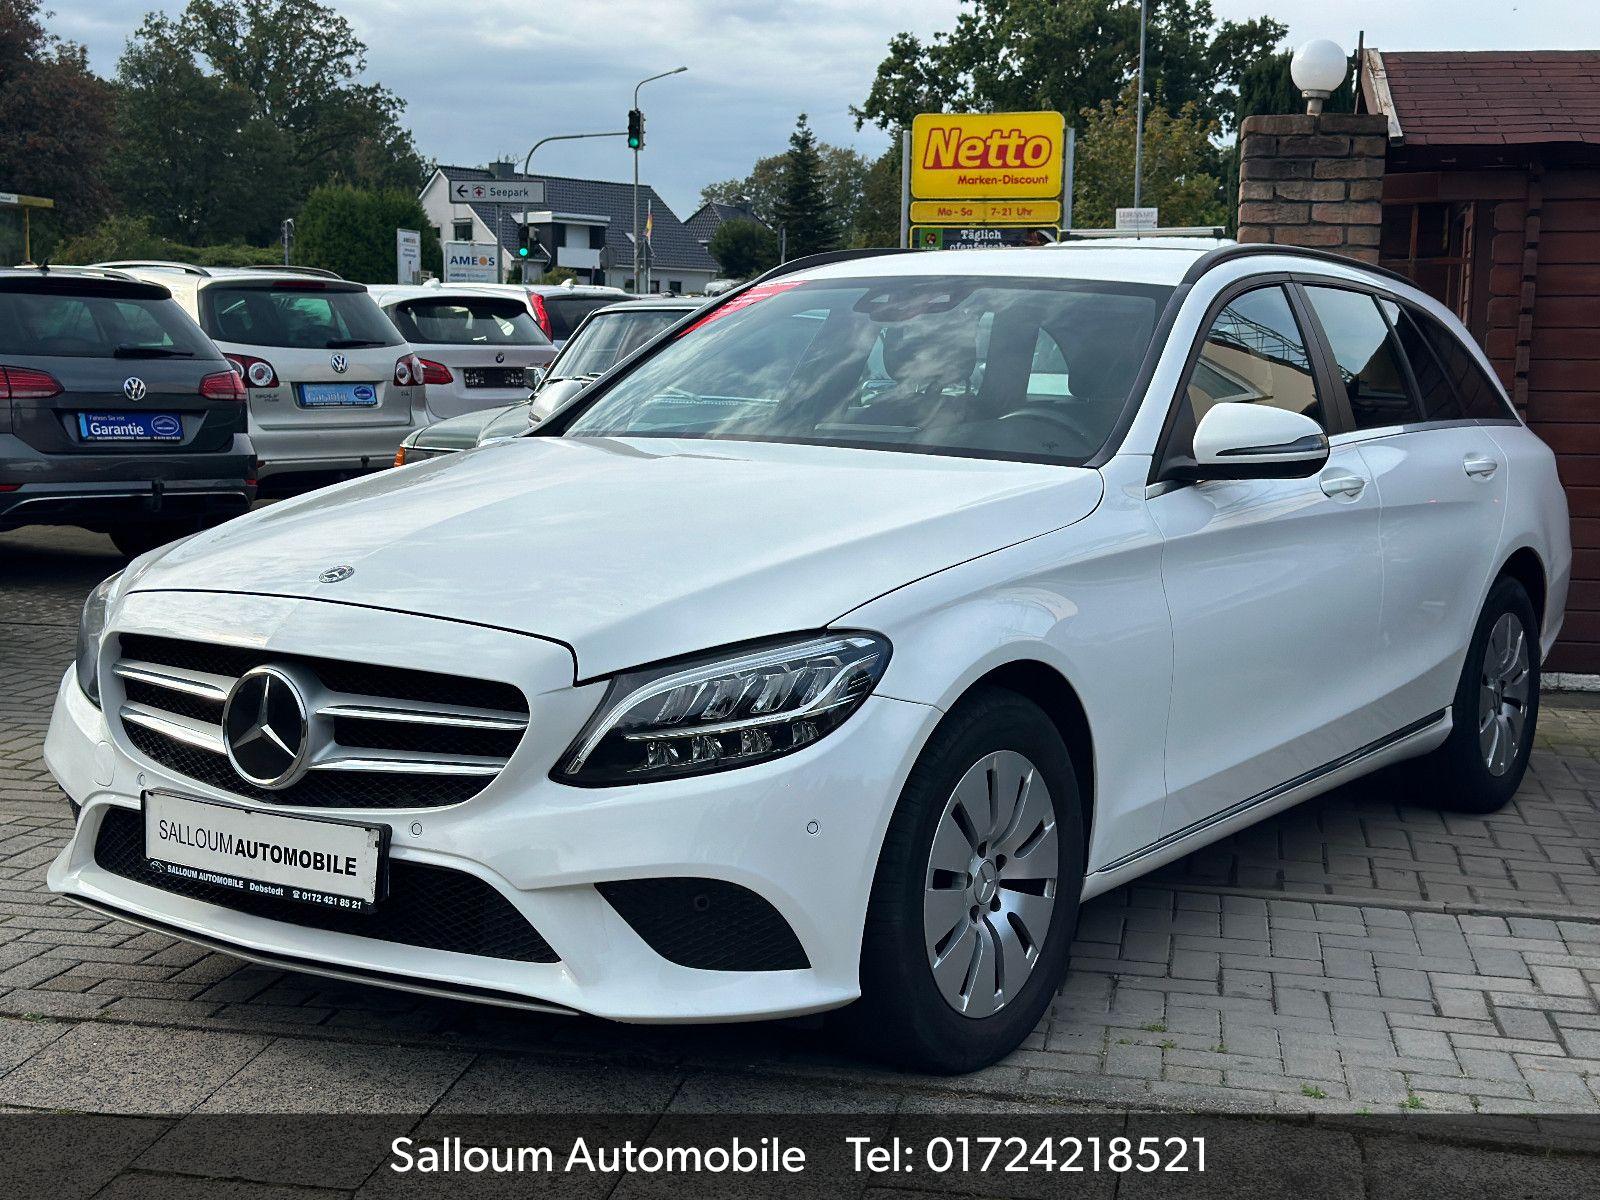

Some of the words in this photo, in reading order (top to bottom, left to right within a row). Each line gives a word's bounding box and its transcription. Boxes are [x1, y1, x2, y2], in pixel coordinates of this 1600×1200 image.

[923, 128, 1052, 169] Netto
[957, 174, 1049, 185] Marken-Discount
[490, 188, 529, 199] Seepark
[1016, 207, 1033, 217] Uhr
[960, 229, 1002, 241] Täglich
[90, 422, 145, 435] Garantie
[167, 864, 198, 879] SALLOUM
[198, 872, 244, 889] AUTOMOBILE
[249, 882, 284, 897] Debstedt
[302, 892, 322, 902] 0172
[323, 895, 338, 905] 421
[339, 898, 350, 908] 85
[351, 900, 362, 910] 21
